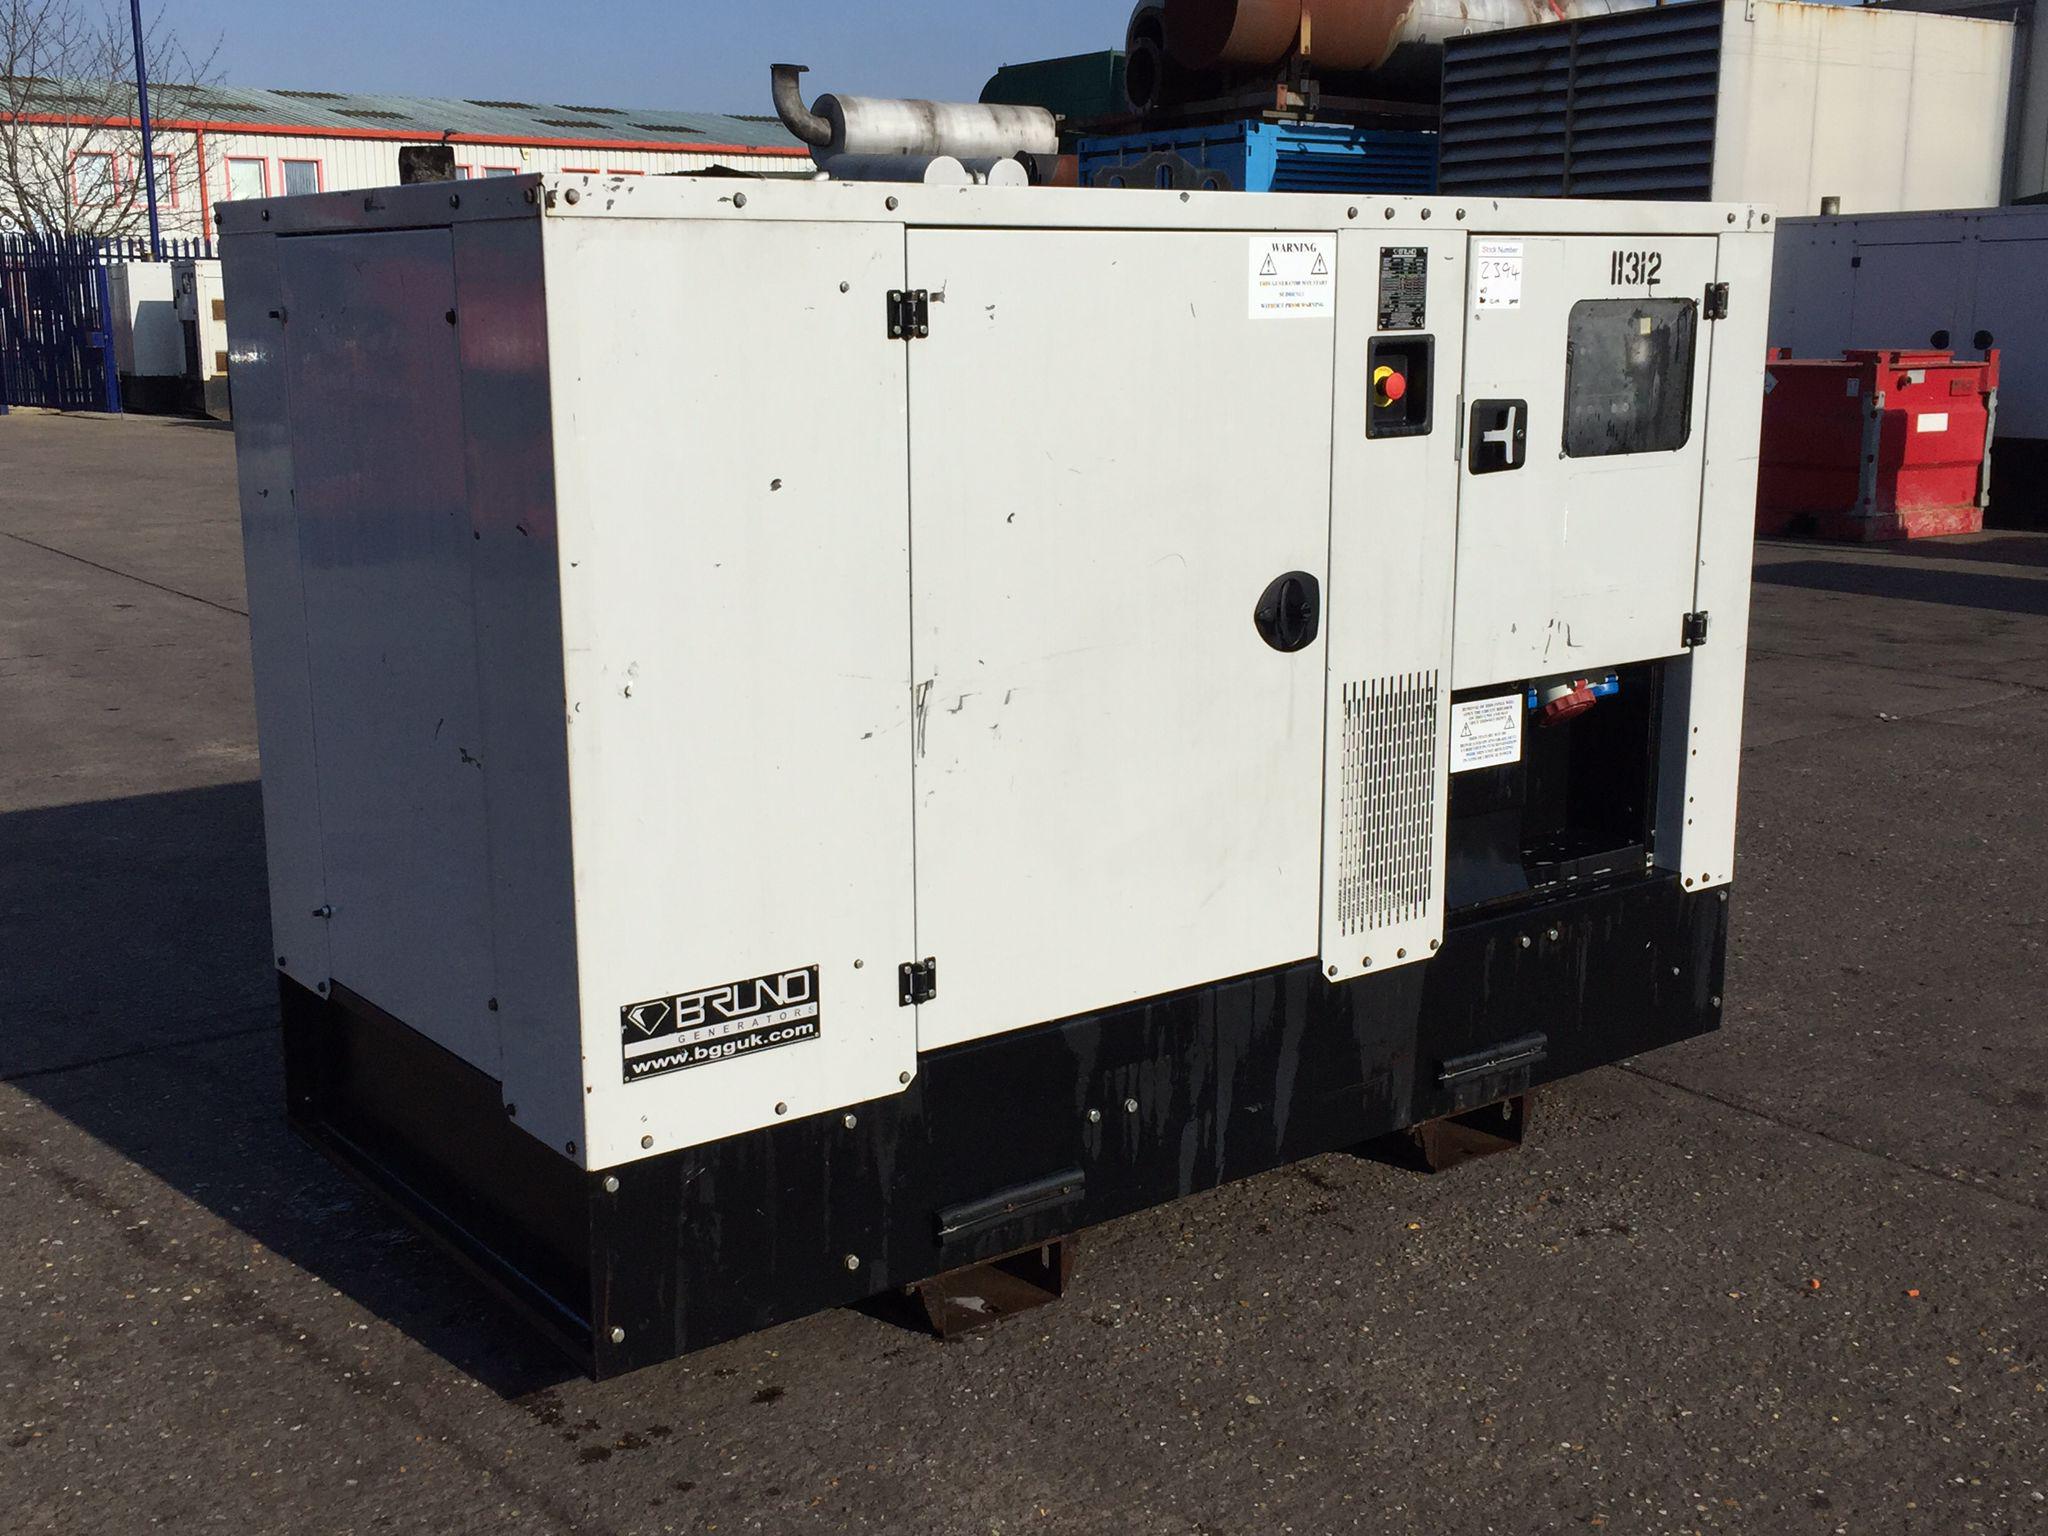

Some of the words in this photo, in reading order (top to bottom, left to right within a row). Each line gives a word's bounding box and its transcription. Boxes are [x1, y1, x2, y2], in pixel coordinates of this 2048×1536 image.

[1272, 243, 1317, 252] WARNING
[1481, 261, 1520, 280] 2394
[1611, 250, 1662, 285] 11312
[676, 969, 810, 1029] BRUNO
[678, 1005, 816, 1044] GENERATORS
[632, 1023, 814, 1074] www.bgguk.com
